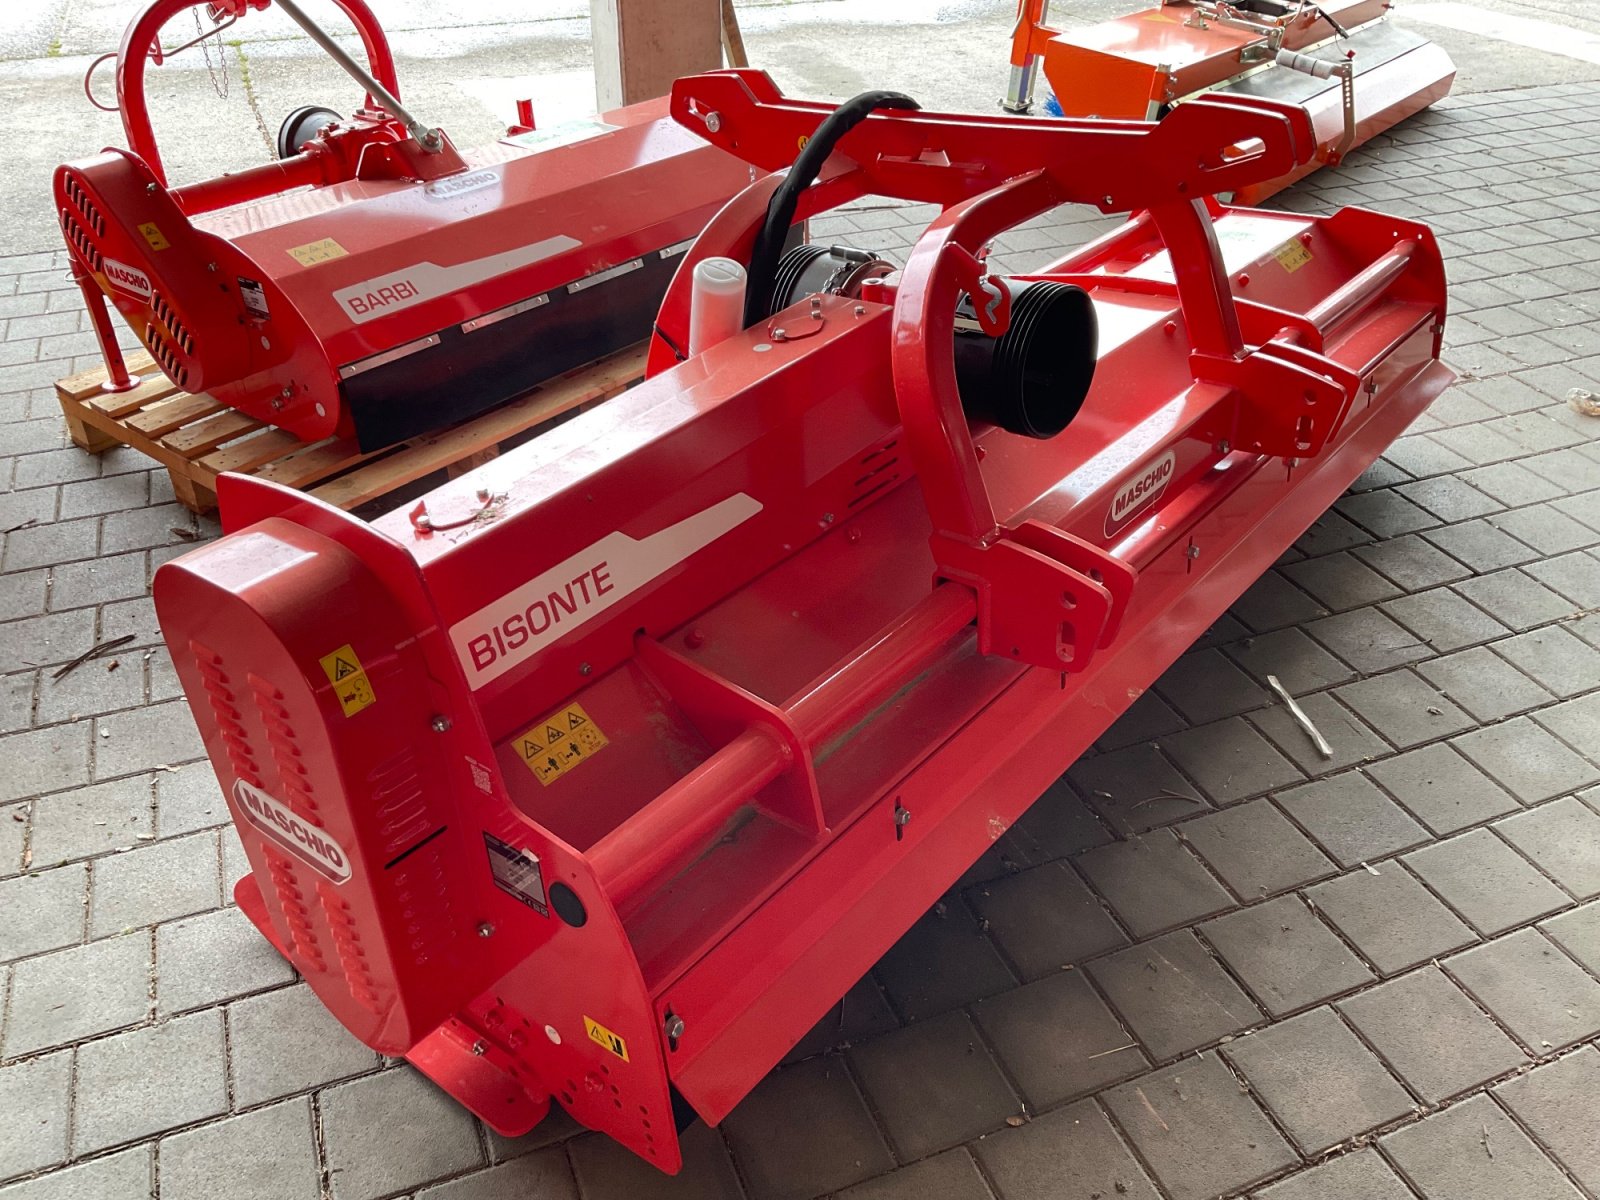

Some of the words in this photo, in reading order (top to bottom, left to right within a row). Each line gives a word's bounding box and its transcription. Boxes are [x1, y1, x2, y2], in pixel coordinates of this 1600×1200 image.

[105, 264, 149, 291] MASCHIO
[347, 280, 419, 315] BARBI
[1115, 459, 1171, 516] MASCHIO
[467, 561, 614, 672] BISONTE
[242, 787, 343, 868] MASCHIO
